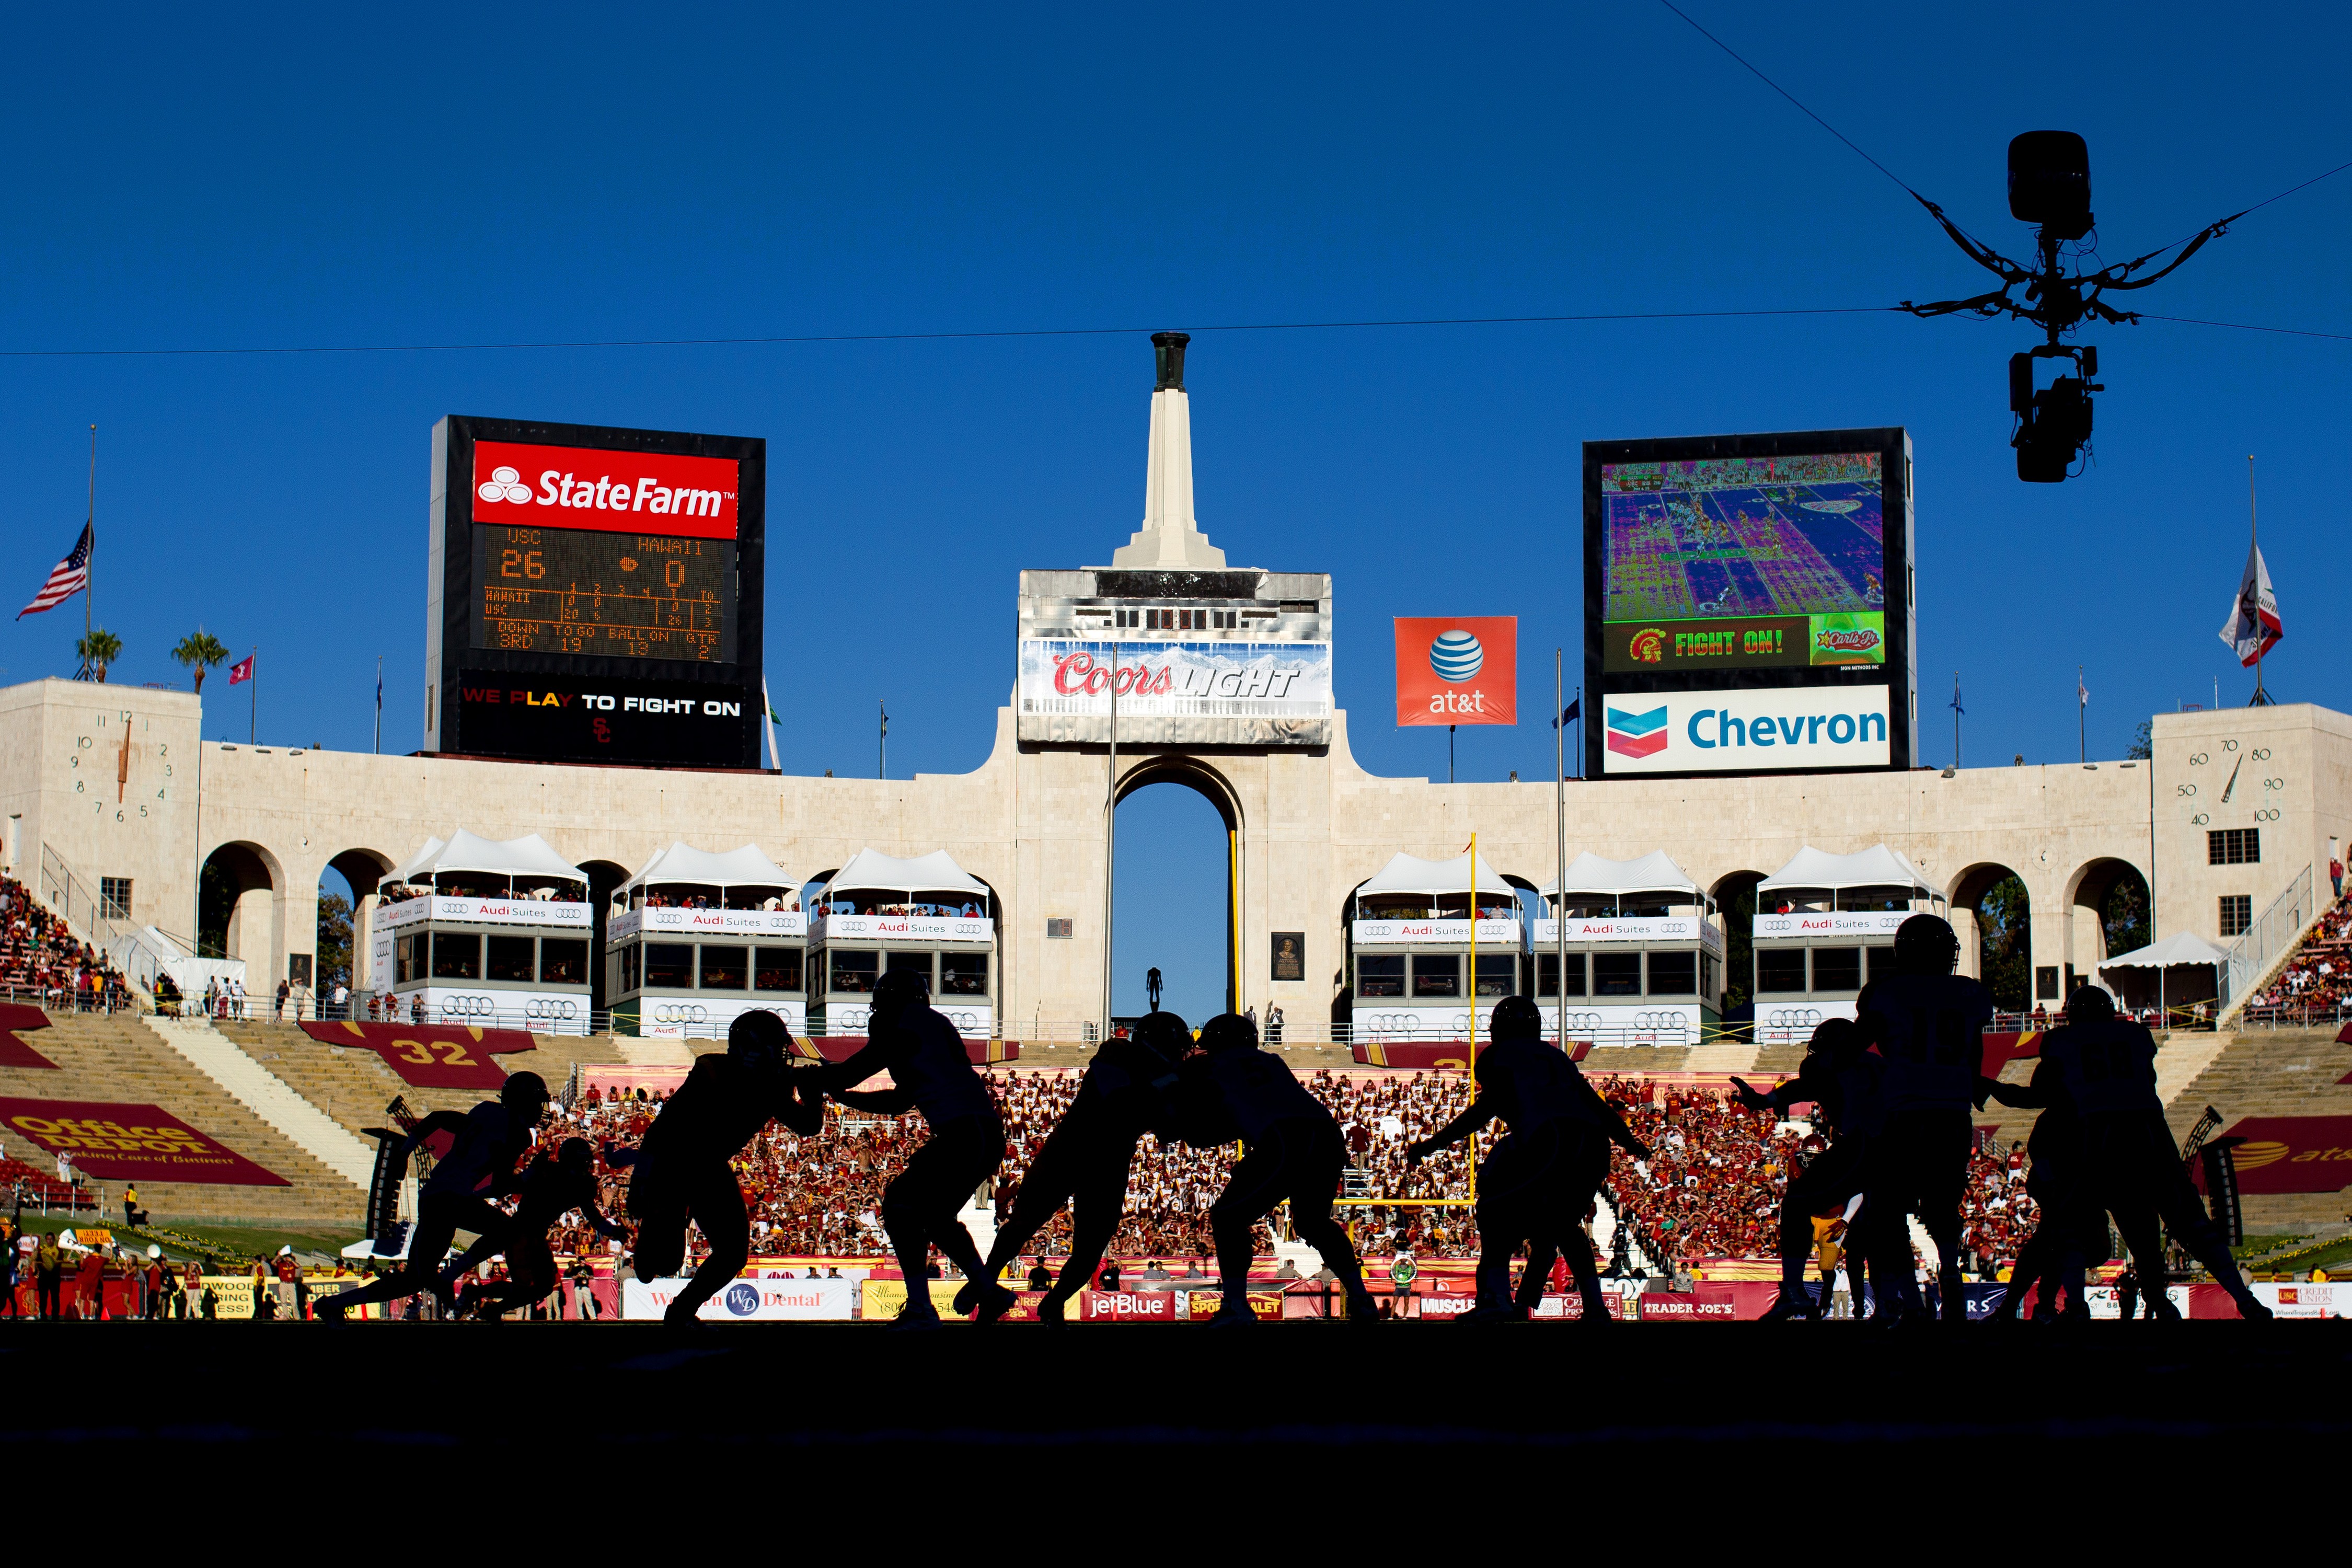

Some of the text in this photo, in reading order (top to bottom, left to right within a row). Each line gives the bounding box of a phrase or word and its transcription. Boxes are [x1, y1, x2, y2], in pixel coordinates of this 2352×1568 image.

[508, 528, 702, 555] USC HAWAII
[502, 549, 685, 587] 26 0
[486, 590, 530, 603] HAWAII
[619, 585, 625, 596] 3
[643, 586, 649, 598] 4
[485, 603, 507, 615] USC
[564, 608, 578, 619] 20
[668, 615, 682, 626] 26
[498, 622, 717, 645] DOWN TO GO BALL ON QTR
[500, 633, 533, 649] 3RD
[562, 637, 582, 652] 19
[699, 645, 709, 660] 2
[1676, 629, 1782, 657] FIGHT ON!
[1053, 652, 1300, 698] Coors LIGHT
[463, 687, 741, 717] WE PLAY TO FIGHT ON
[1429, 690, 1484, 713] at&t
[1688, 709, 1886, 749] Chevron
[78, 736, 92, 749] 10
[2221, 740, 2238, 752] 70
[160, 744, 167, 756] 2
[2252, 748, 2271, 761] 80
[71, 756, 79, 768] 9
[2190, 753, 2209, 766] 60
[165, 765, 172, 777] 3
[76, 781, 85, 793] 8
[2177, 784, 2197, 797] 50
[2264, 778, 2284, 791] 90
[157, 788, 165, 800] 4
[95, 802, 102, 814] 7
[140, 805, 148, 817] 5
[116, 810, 124, 822] 6
[2192, 813, 2209, 825] 40
[2253, 809, 2280, 822] 100
[479, 905, 546, 917] Audi Suites
[693, 915, 761, 927] Audi Suites
[878, 922, 946, 933] Audi Suites
[1801, 919, 1870, 929] Audi Suites
[1401, 926, 1470, 936] Audi Suites
[1583, 925, 1651, 934] Audi Suites
[391, 1040, 478, 1066] 32
[11, 1116, 196, 1141] Office
[34, 1133, 212, 1154] DEPOT
[71, 1150, 235, 1165] aking Care of Business
[764, 1291, 821, 1307] Dental
[2279, 1292, 2298, 1300] USC
[1090, 1295, 1163, 1318] jetBlue
[1644, 1303, 1694, 1313] TRADER
[1697, 1303, 1733, 1314] JOE'S
